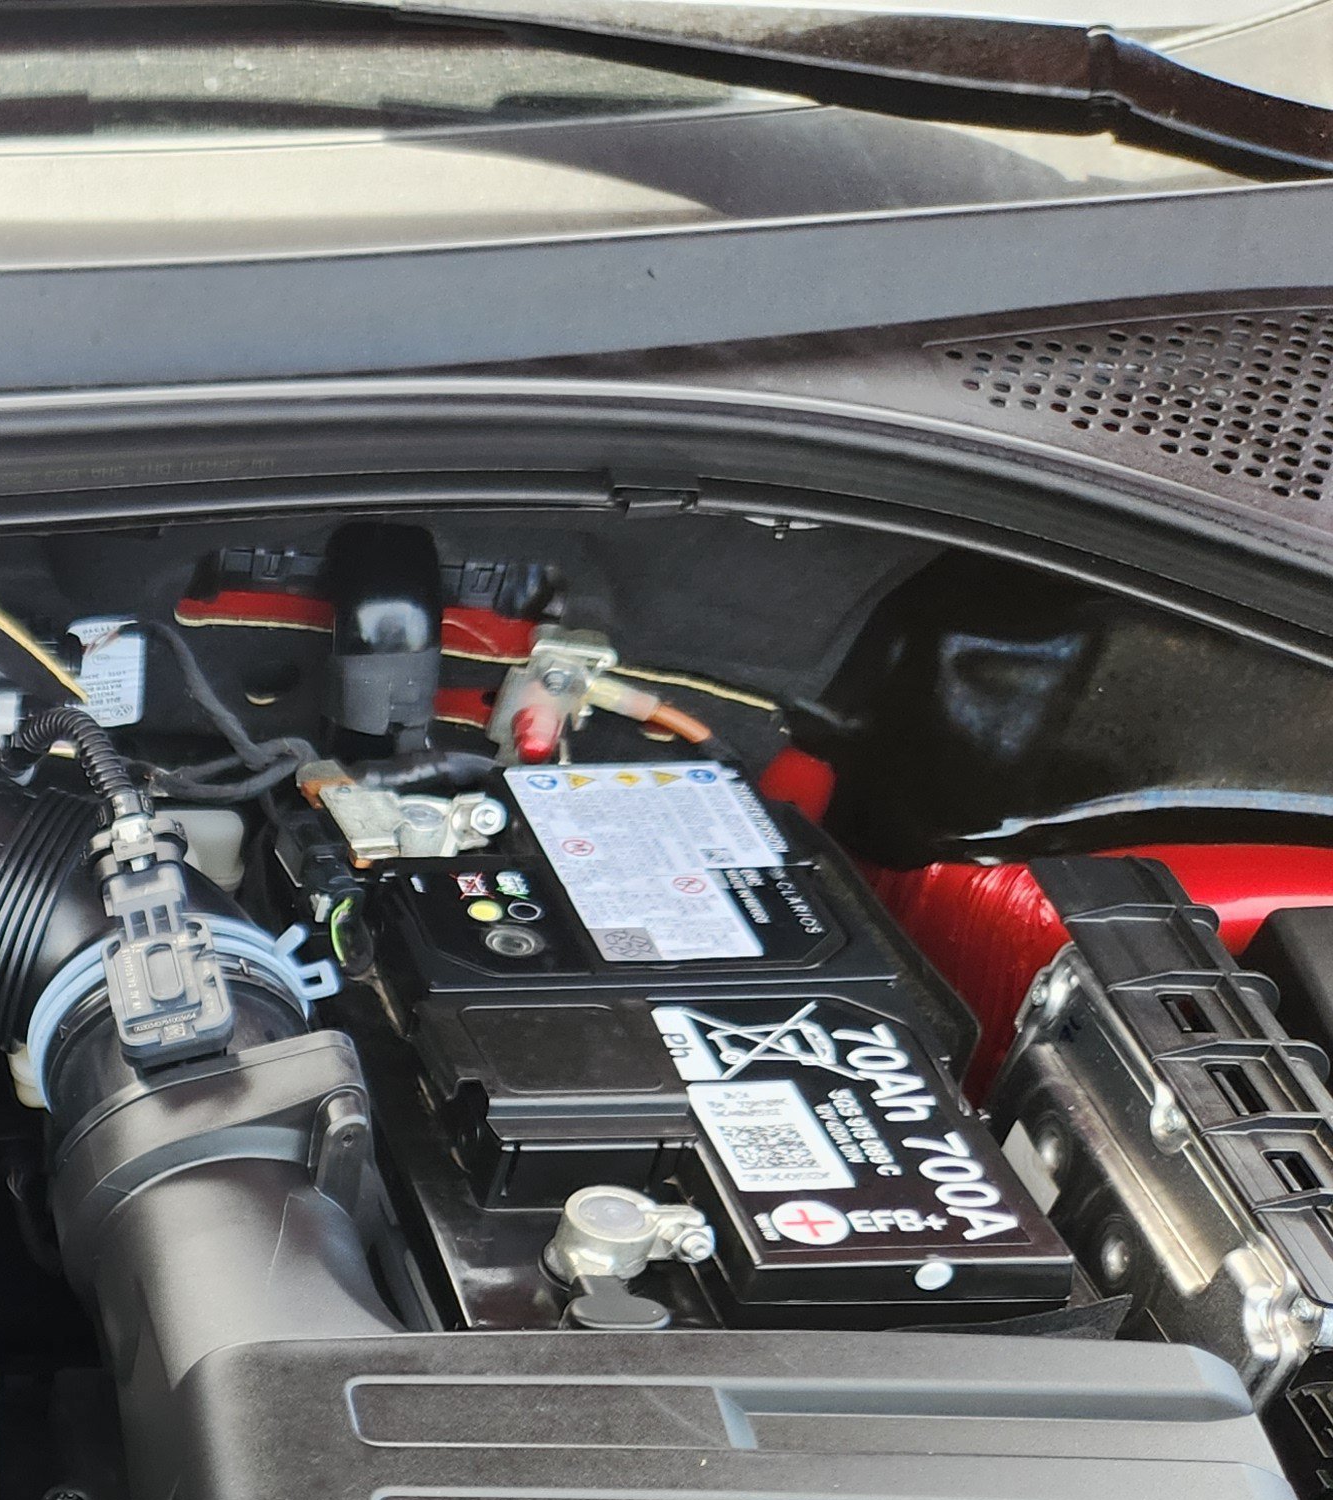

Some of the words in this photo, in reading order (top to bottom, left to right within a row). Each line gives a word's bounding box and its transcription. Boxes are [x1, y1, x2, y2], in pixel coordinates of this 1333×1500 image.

[776, 880, 827, 934] CLARIOS
[831, 1023, 936, 1122] 70Ah
[901, 1131, 1019, 1241] 700A
[846, 1209, 948, 1233] EFB+
